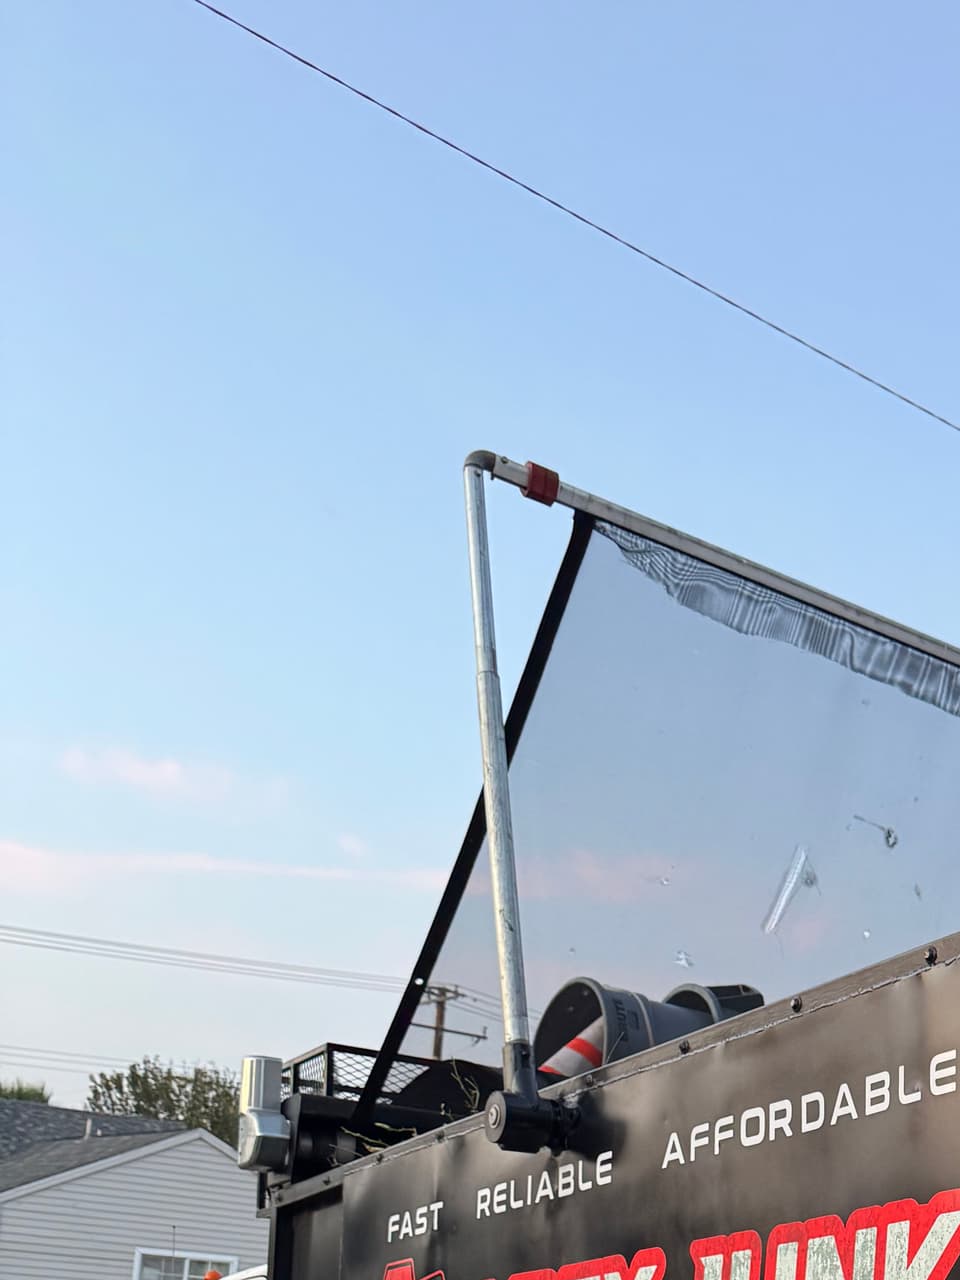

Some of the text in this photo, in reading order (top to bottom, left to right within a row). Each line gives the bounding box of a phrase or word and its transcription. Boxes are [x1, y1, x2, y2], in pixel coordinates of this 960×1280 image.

[386, 1048, 958, 1242] FAST RELIABLE AFFORDABLE
